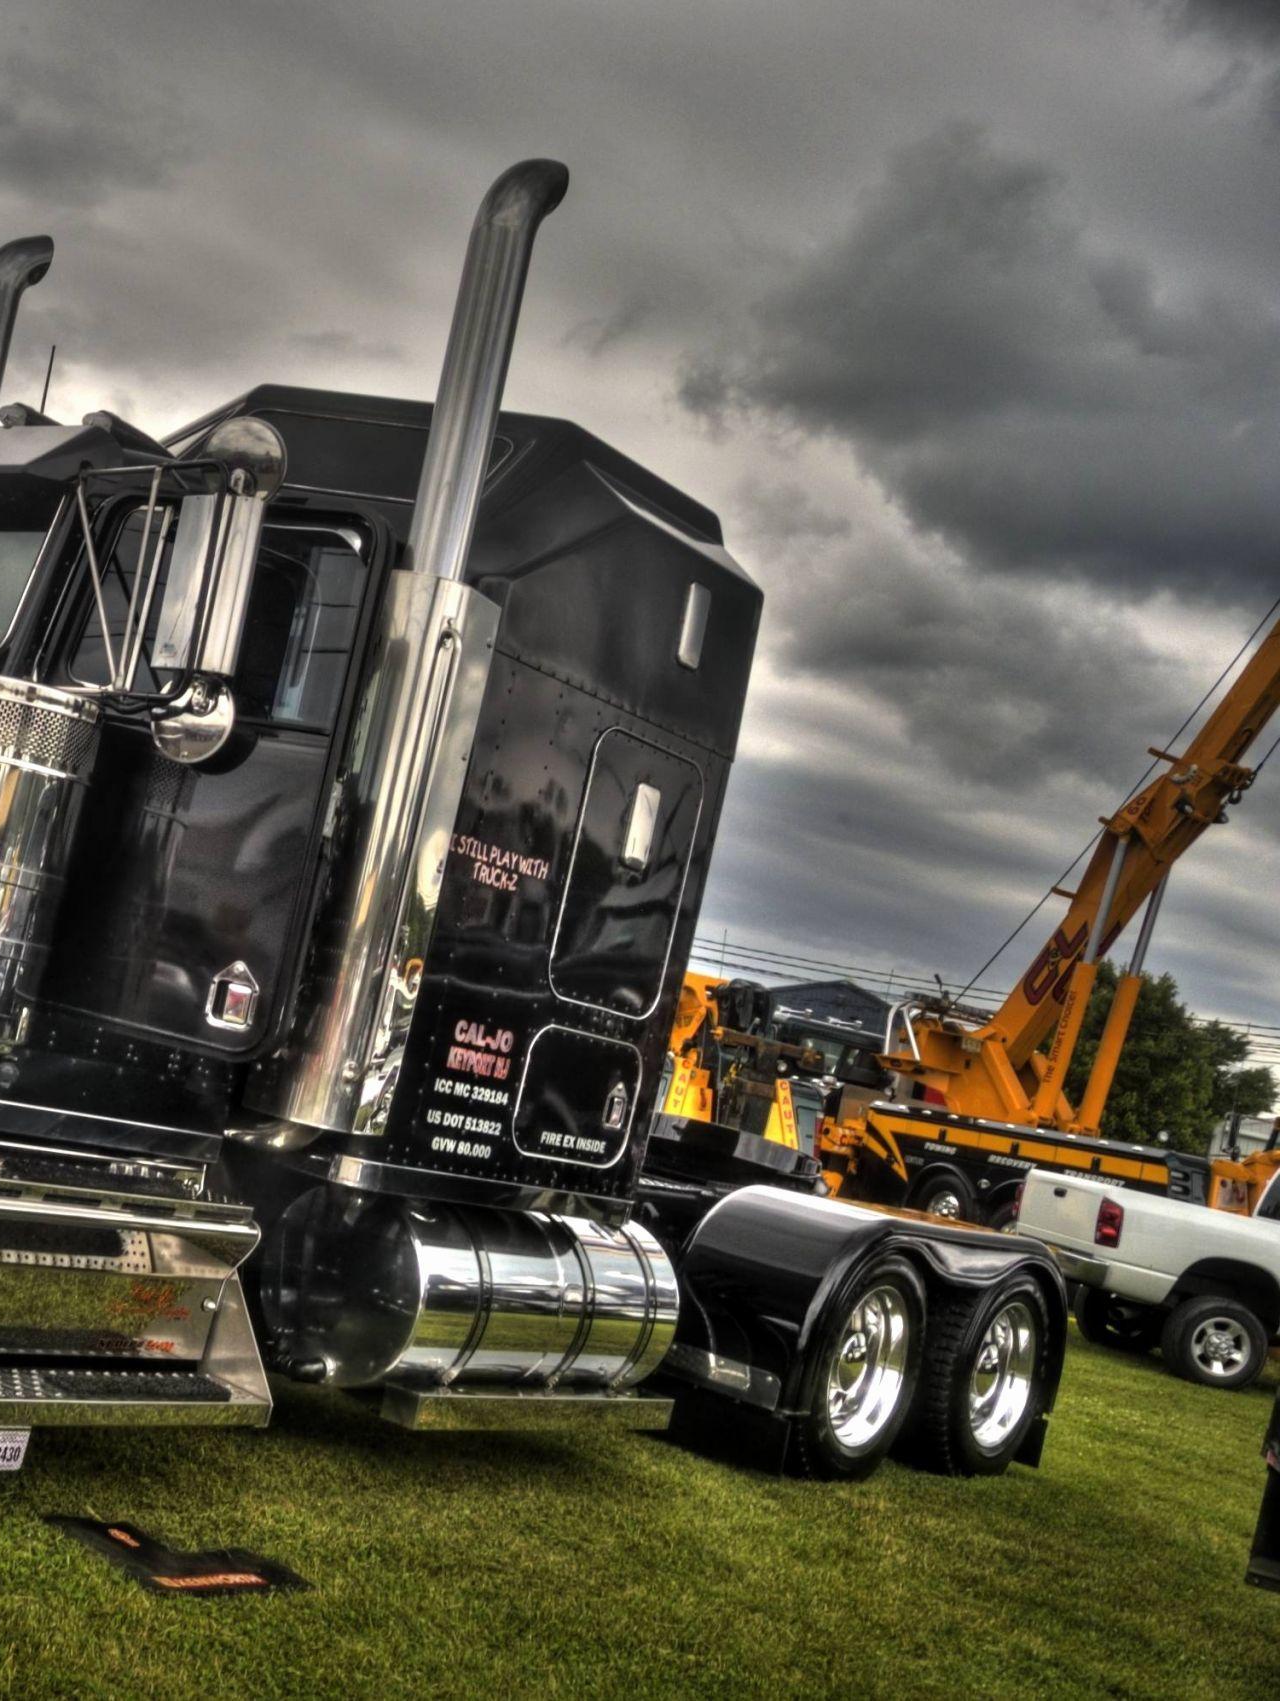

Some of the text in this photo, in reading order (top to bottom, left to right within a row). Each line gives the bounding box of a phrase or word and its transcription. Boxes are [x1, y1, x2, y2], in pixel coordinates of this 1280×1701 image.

[457, 836, 488, 861] STILL
[489, 845, 518, 870] PLAY
[519, 855, 549, 879] WITH
[455, 1020, 514, 1053] CAL-JO
[434, 1078, 509, 1106] ICC MC 329184
[427, 1109, 502, 1136] US DOT 513822
[431, 1136, 456, 1153] GVW
[540, 1131, 606, 1154] FIRE EX INSIDE
[987, 1154, 1038, 1169] RECOVERY
[1064, 1169, 1127, 1188] TRANSPORT
